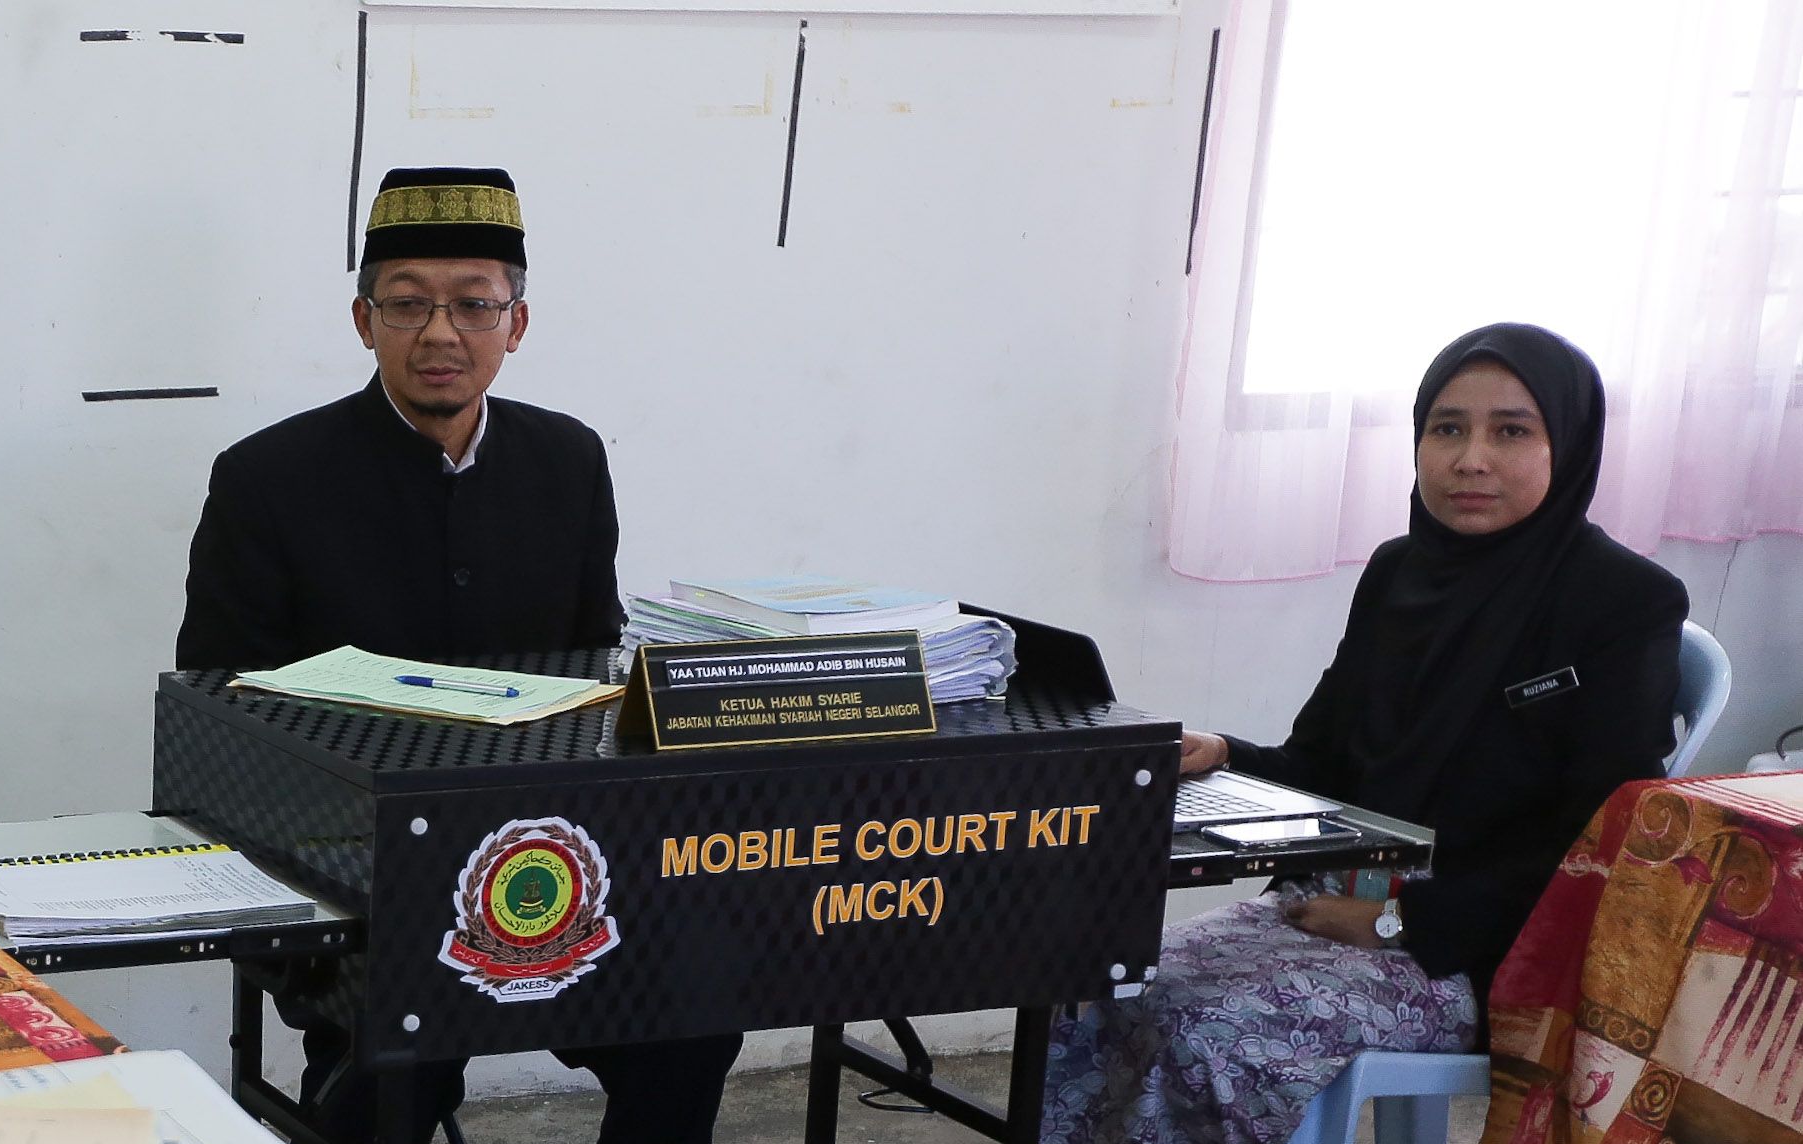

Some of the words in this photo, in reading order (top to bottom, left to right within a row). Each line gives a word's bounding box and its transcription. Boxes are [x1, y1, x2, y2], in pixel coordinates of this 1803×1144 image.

[669, 667, 694, 680] YAA
[695, 665, 726, 679] TUAN
[728, 665, 747, 678] HJ.
[747, 661, 815, 676] MOHAMMAD
[816, 660, 844, 672] ADIB
[845, 659, 864, 671] BIN
[865, 656, 907, 669] HUSAIN
[1522, 678, 1560, 697] RUZIANA
[720, 697, 766, 712] KETUA
[771, 694, 813, 709] HAKIM
[818, 691, 863, 706] SYARIE
[666, 715, 712, 730] JABATAN
[715, 712, 776, 728] KEHAKIMAN
[779, 710, 823, 725] SYARIAH
[825, 707, 862, 722] NEGERI
[865, 703, 921, 718] SELANGOR
[660, 823, 841, 878] MOBILE
[854, 810, 1017, 862] COURT
[1028, 804, 1101, 849] KIT
[811, 876, 945, 935] (MCK)
[507, 979, 550, 992] JAKESS
